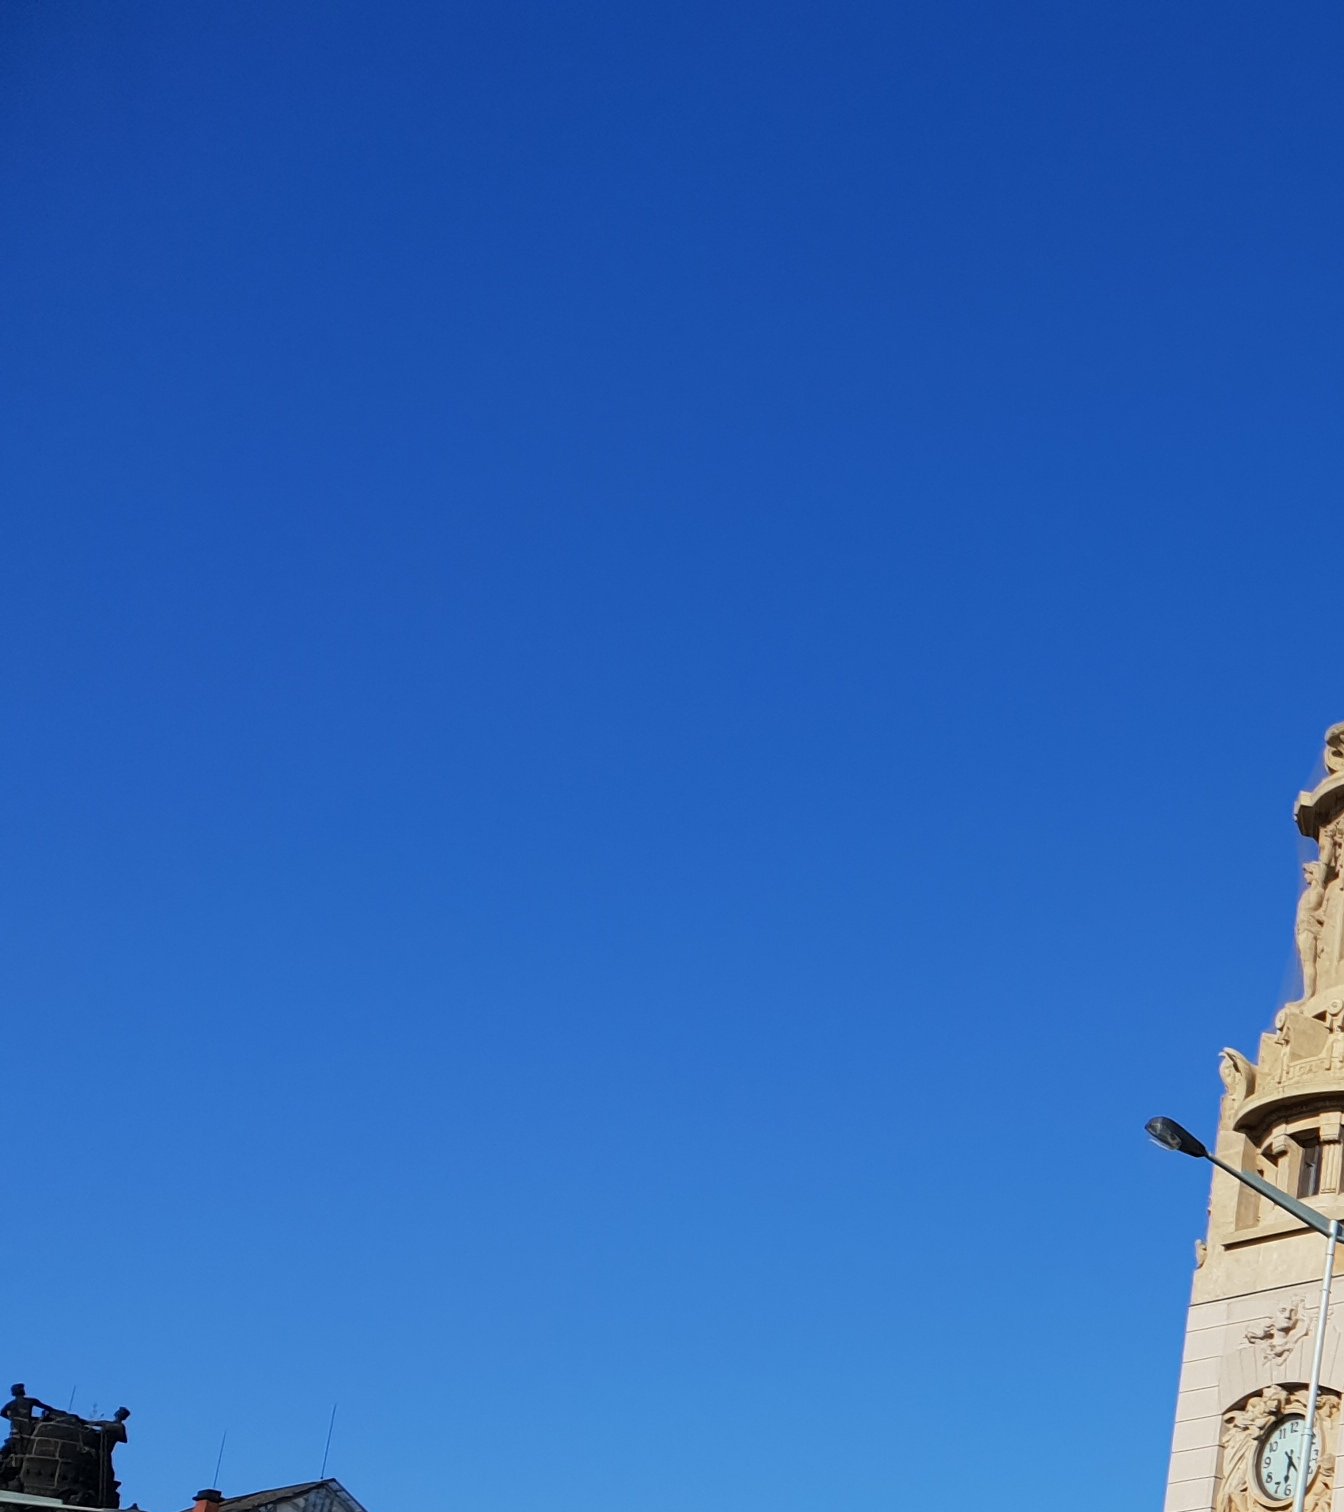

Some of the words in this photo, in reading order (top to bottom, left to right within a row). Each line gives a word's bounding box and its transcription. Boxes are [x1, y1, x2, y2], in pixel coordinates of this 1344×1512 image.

[1279, 1427, 1286, 1440] 11
[1290, 1421, 1299, 1433] 12
[1269, 1441, 1278, 1453] 10
[1263, 1456, 1271, 1469] 9
[1274, 1481, 1281, 1494] 7
[1284, 1483, 1292, 1496] 6
